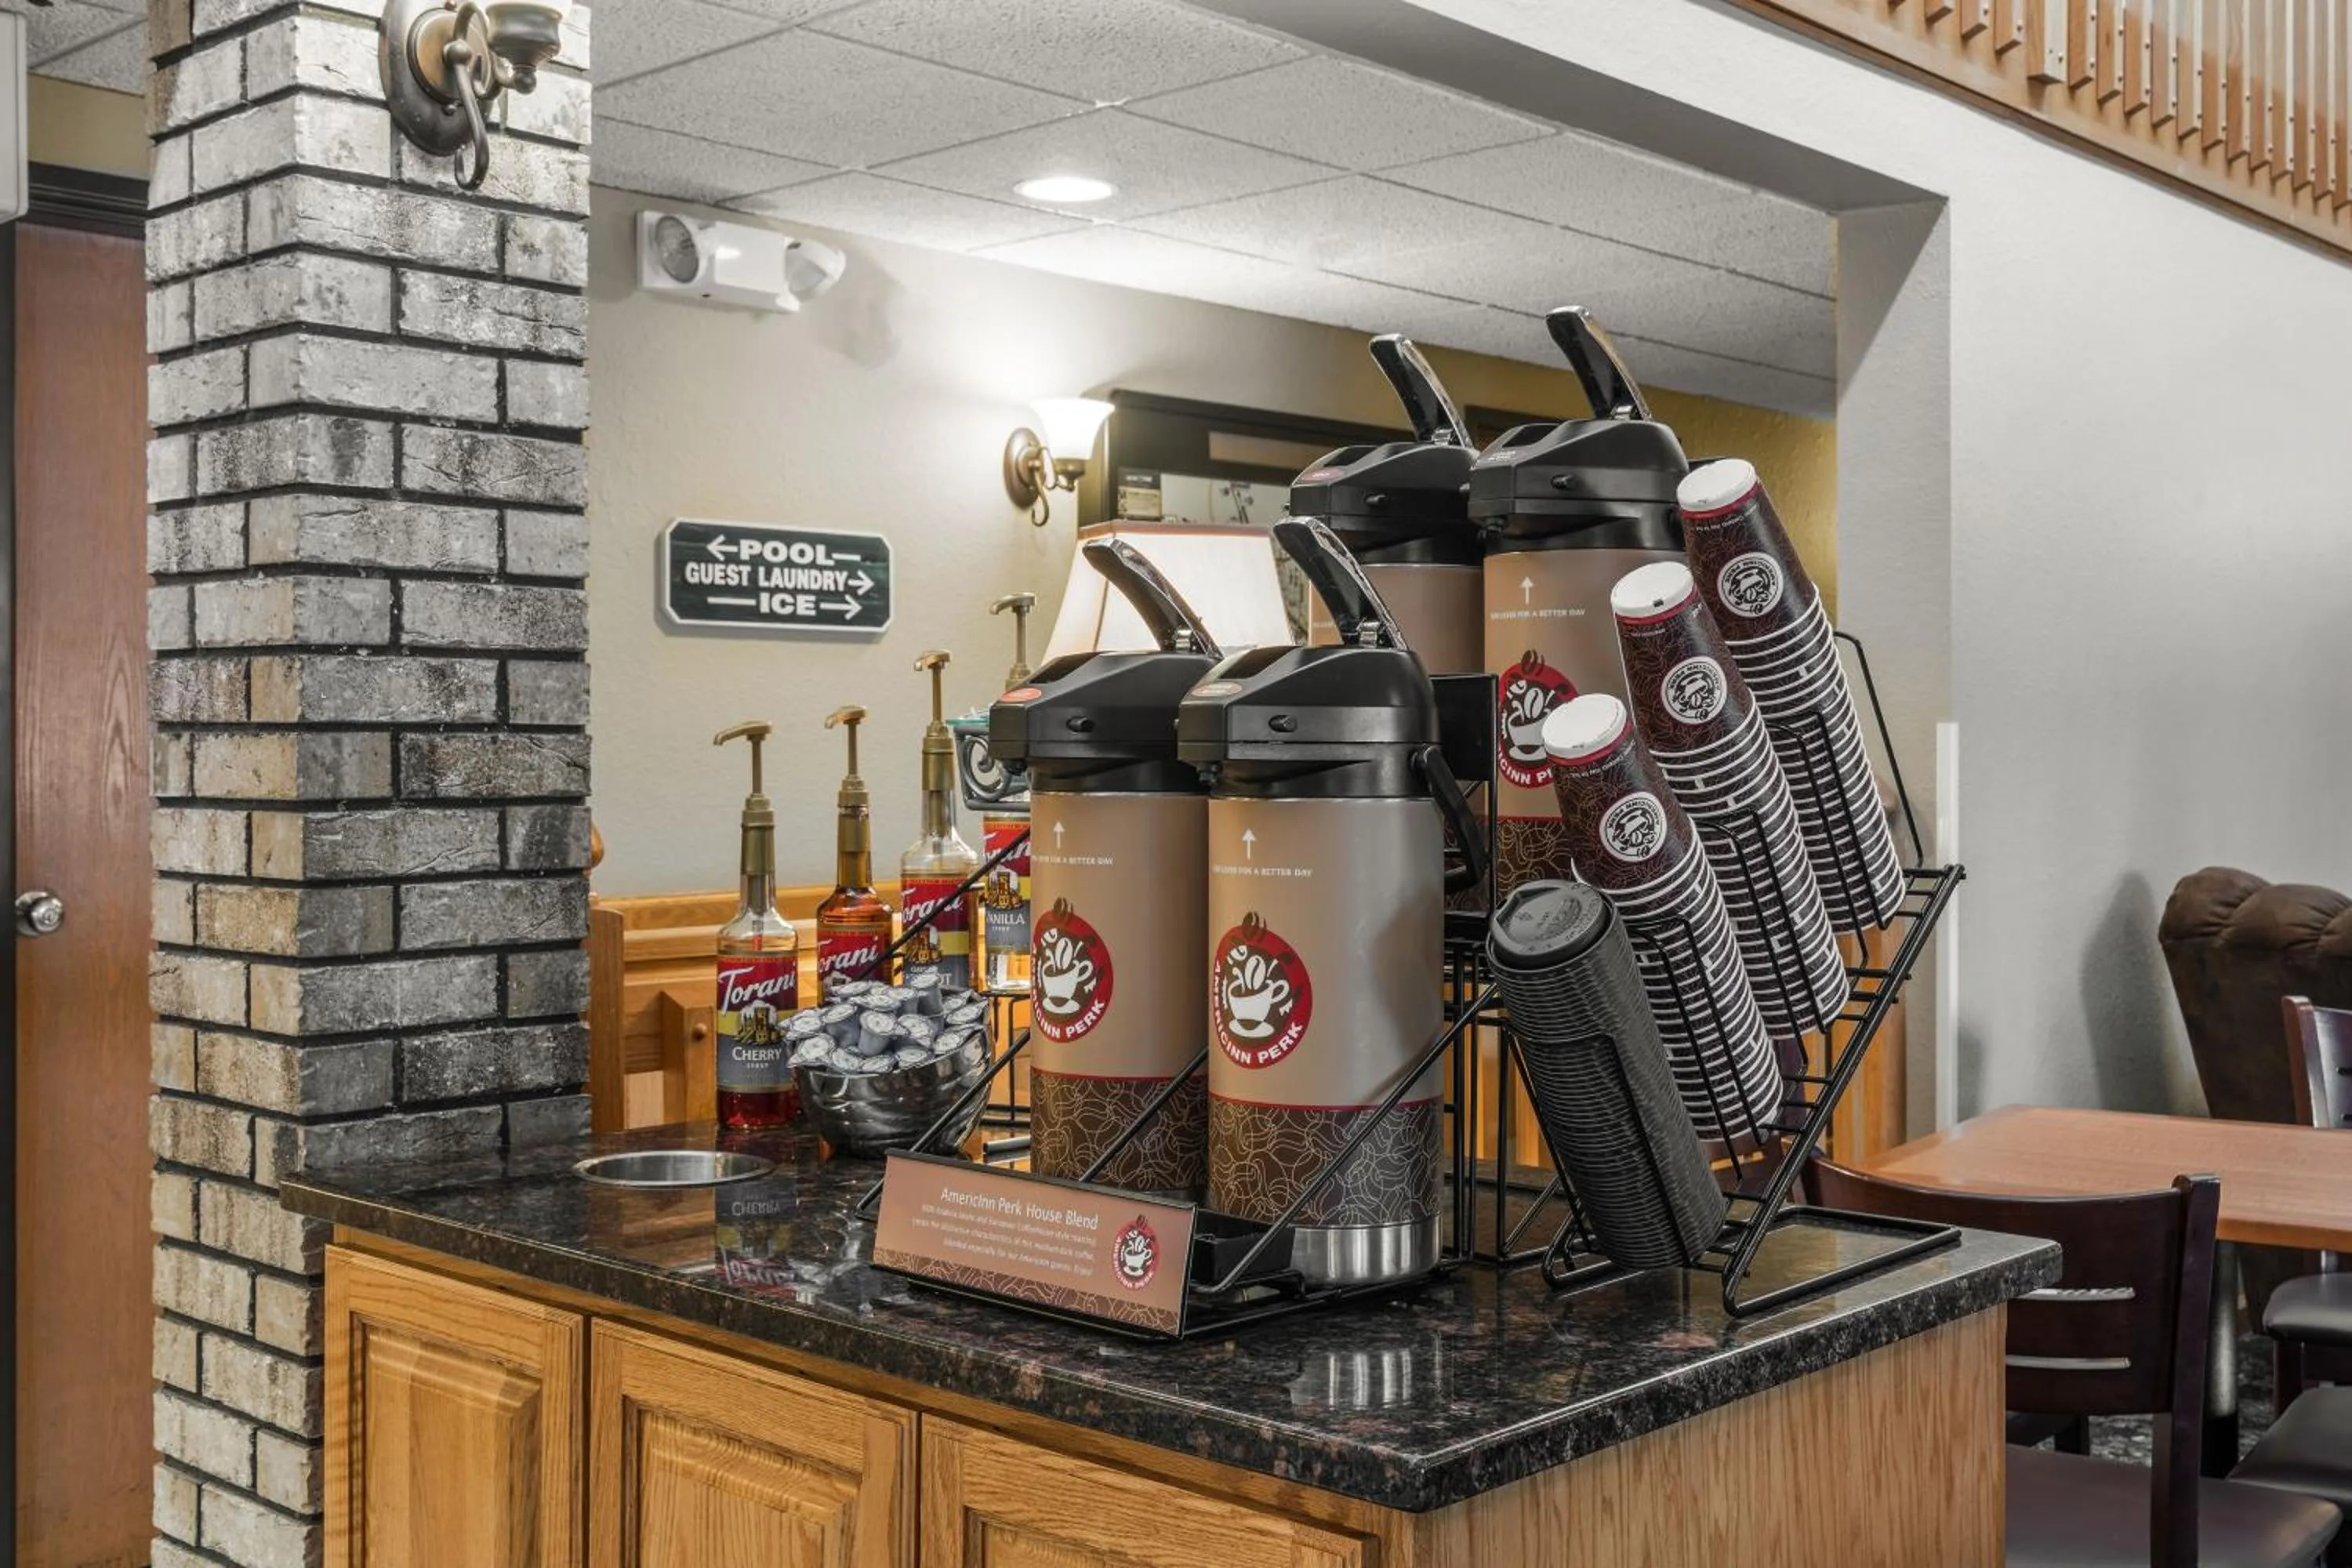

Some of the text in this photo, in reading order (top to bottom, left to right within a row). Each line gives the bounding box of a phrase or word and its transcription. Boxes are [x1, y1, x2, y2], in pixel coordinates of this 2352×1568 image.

[739, 539, 834, 565] POOL
[685, 561, 848, 591] GUEST LAUNDRY
[758, 592, 816, 615] ICE
[1261, 868, 1292, 877] BETTER
[1294, 868, 1312, 877] DAY
[718, 960, 797, 1016] Torani
[1066, 998, 1105, 1039] PERK
[732, 1047, 782, 1061] CHERRY
[1258, 1022, 1303, 1064] PERK
[941, 1188, 996, 1211] AmericInn
[998, 1197, 1022, 1216] Perk
[1026, 1203, 1063, 1223] House
[1065, 1210, 1098, 1230] Blend
